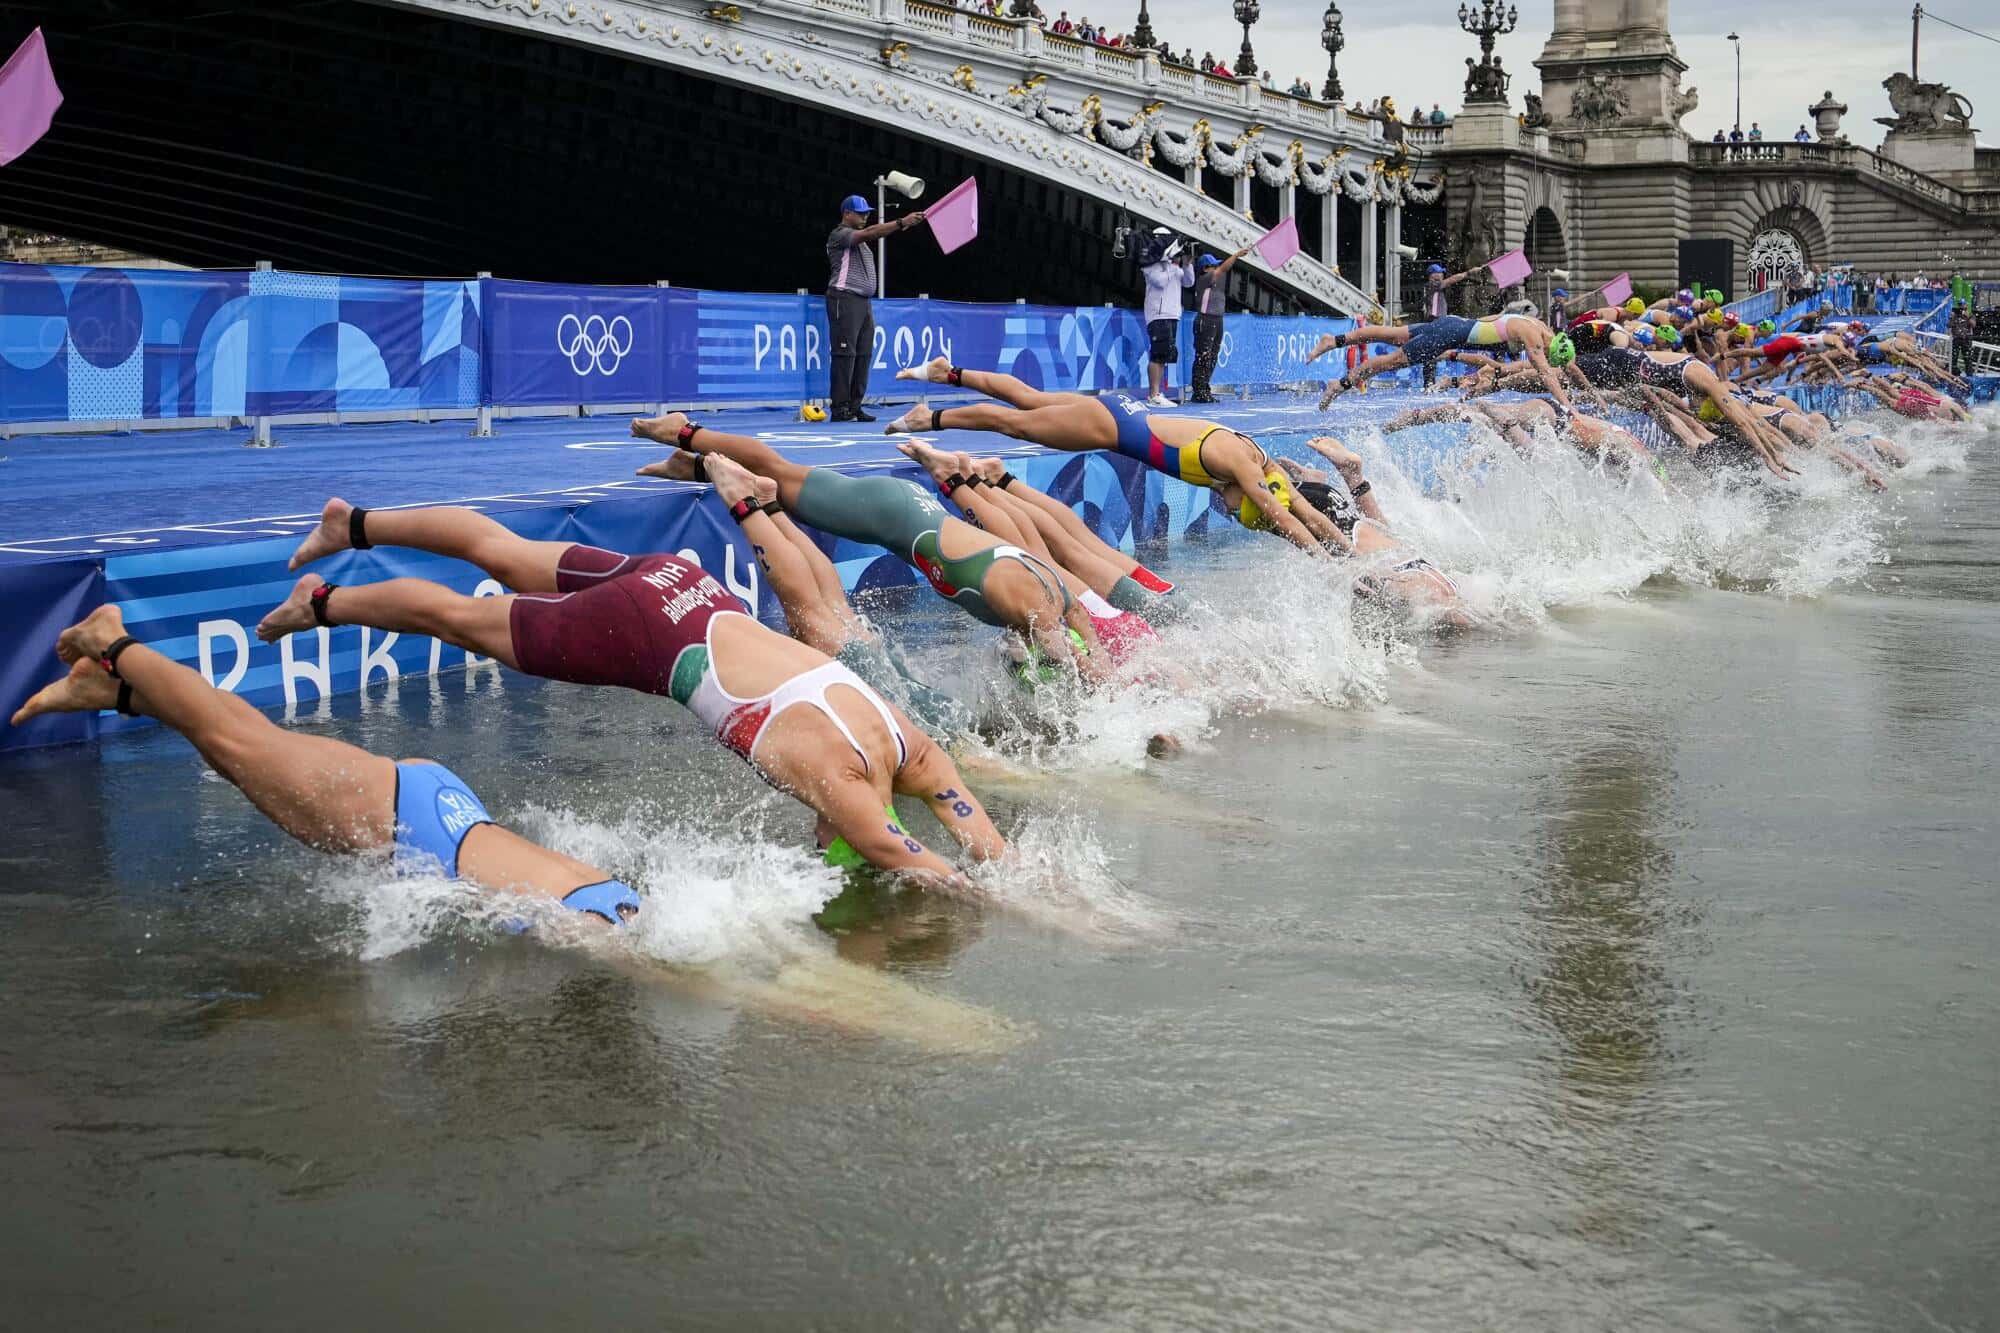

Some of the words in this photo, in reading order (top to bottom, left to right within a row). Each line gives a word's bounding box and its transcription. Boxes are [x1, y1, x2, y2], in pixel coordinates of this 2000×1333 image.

[754, 324, 832, 371] PAR
[873, 326, 953, 369] 2024
[641, 562, 688, 590] HUN
